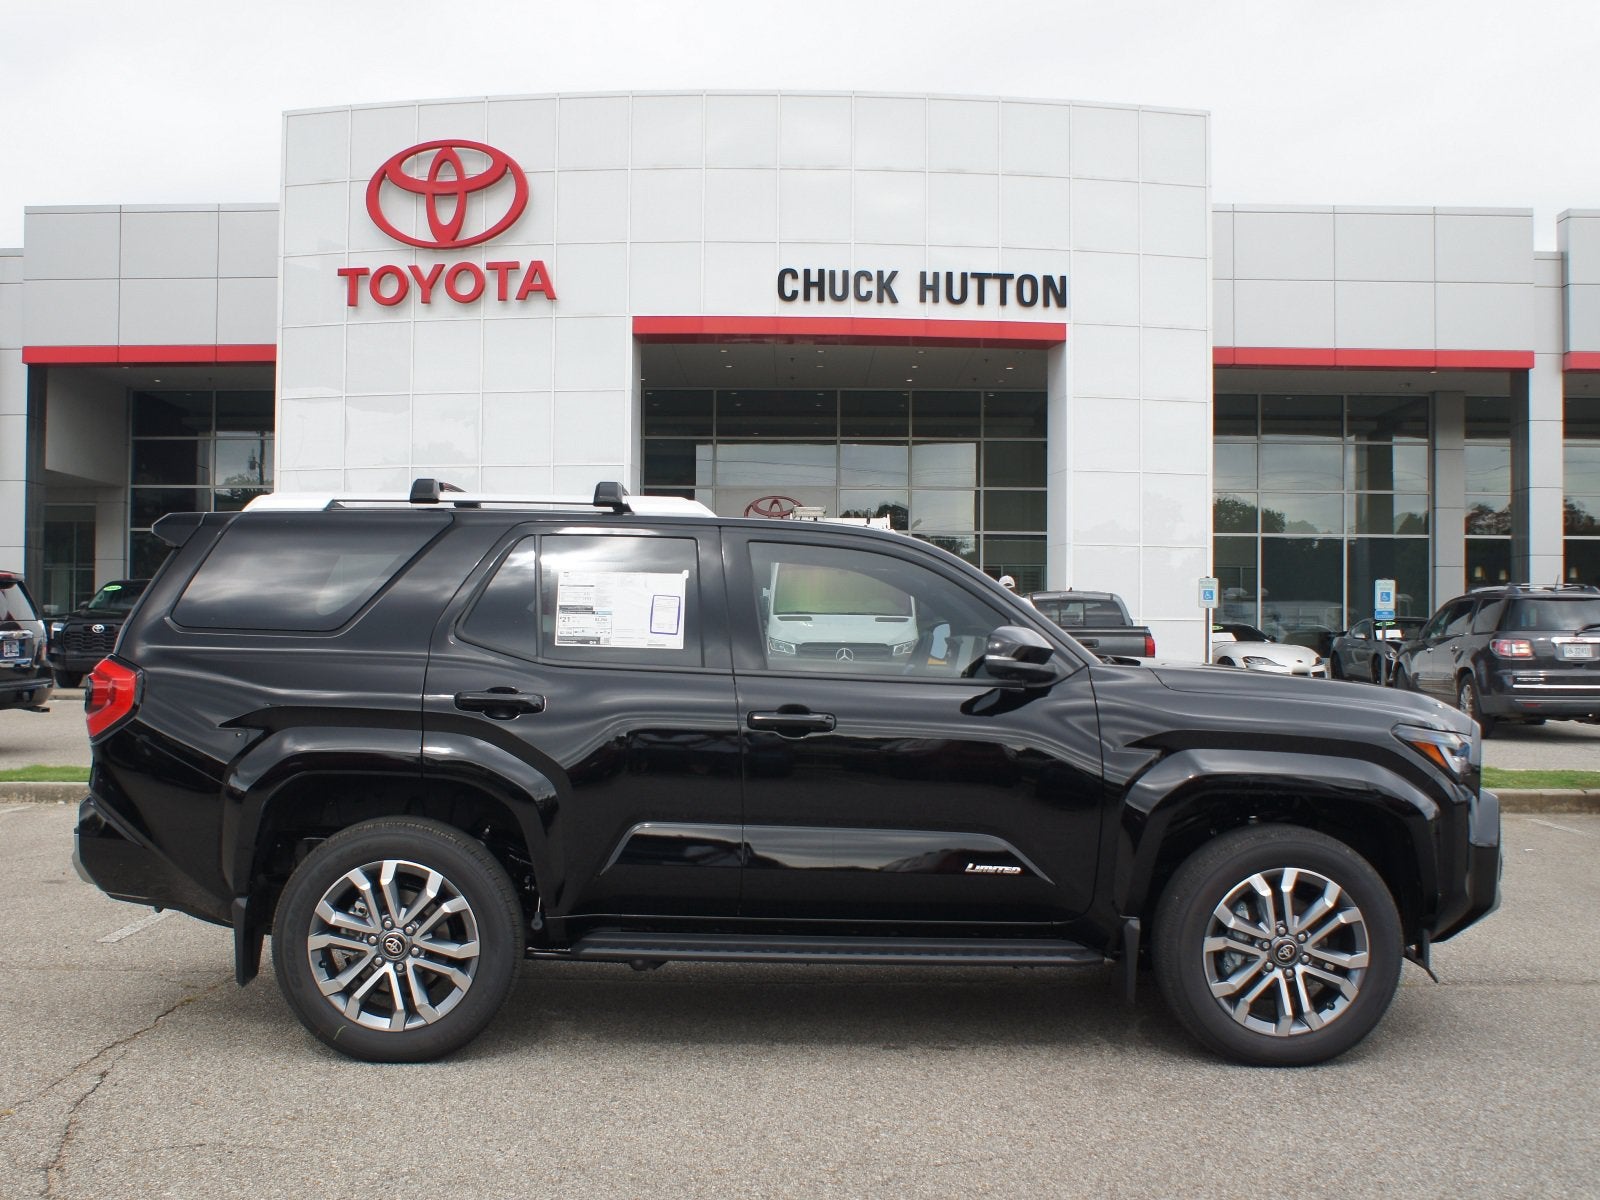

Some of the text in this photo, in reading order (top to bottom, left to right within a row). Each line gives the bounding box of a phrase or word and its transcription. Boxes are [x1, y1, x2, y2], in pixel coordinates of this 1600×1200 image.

[337, 260, 557, 307] TOYOTA
[777, 268, 1067, 308] CHUCK HUTTON
